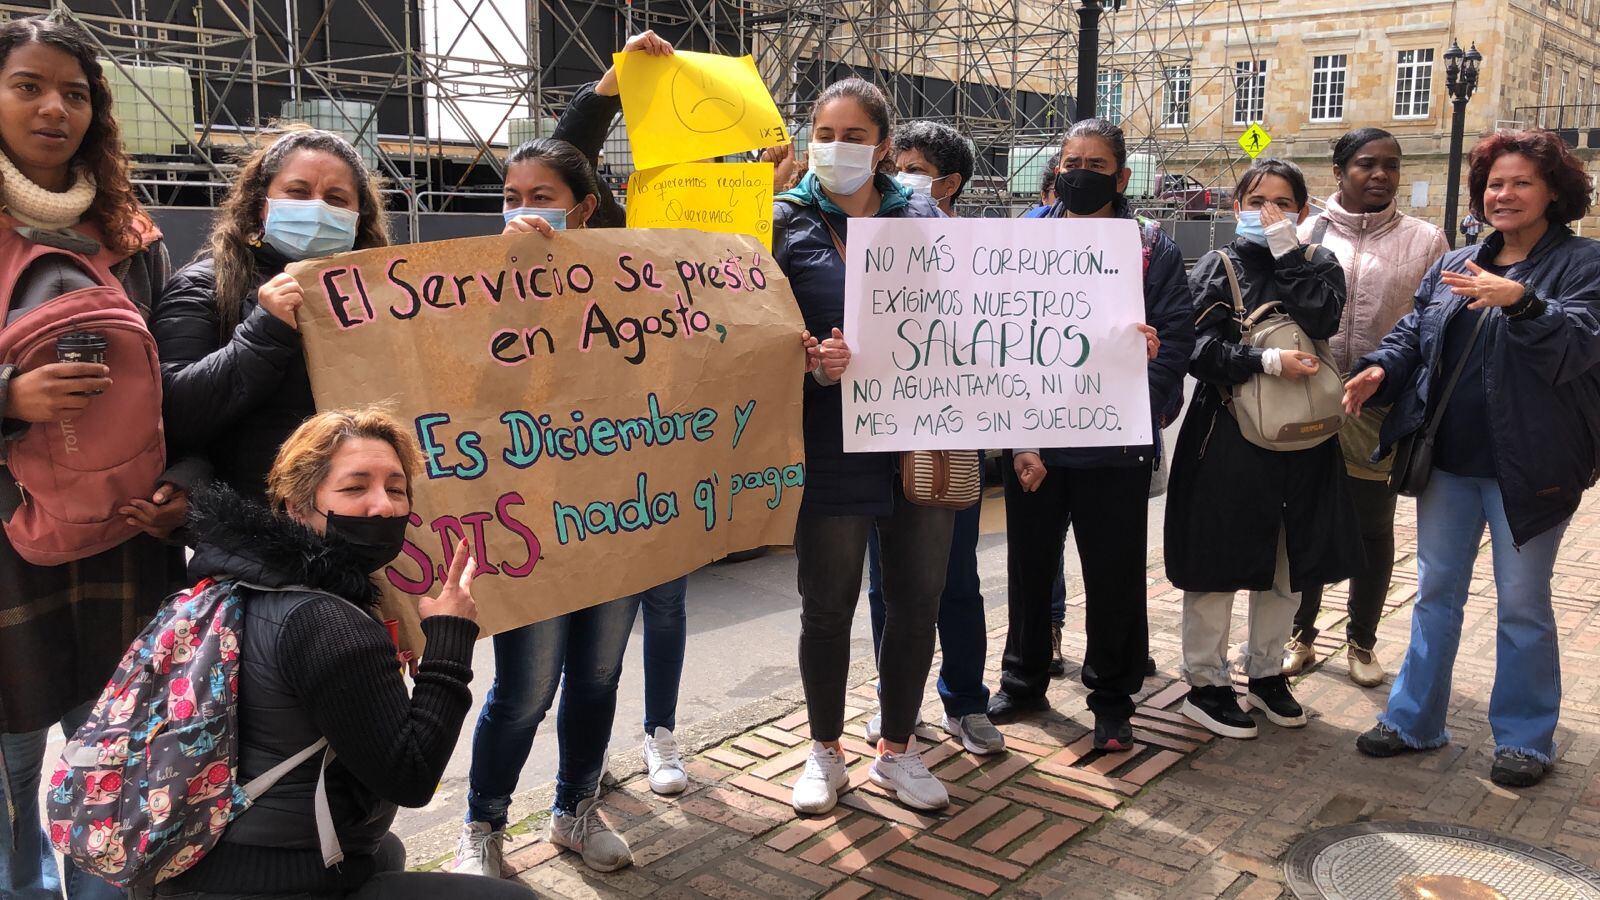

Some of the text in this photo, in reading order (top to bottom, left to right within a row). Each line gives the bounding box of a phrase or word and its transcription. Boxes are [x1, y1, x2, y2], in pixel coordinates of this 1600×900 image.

[632, 173, 649, 196] No
[653, 178, 707, 201] queremos
[665, 198, 734, 224] Queremos
[865, 246, 895, 273] NO
[906, 234, 956, 275] MÁS
[319, 264, 376, 331] El
[384, 253, 594, 320] Servicio
[674, 249, 767, 306] prestó
[973, 290, 1092, 320] NUESTROS
[488, 291, 728, 367] en Agosto,
[853, 372, 1101, 404] NO AGUANTAMOS, NI UN
[415, 412, 488, 480] Es
[500, 392, 718, 470] Diciembre
[855, 404, 1123, 437] MES MÁS SIN SUELDOS.
[553, 472, 680, 545] nada
[156, 765, 181, 783] hello
